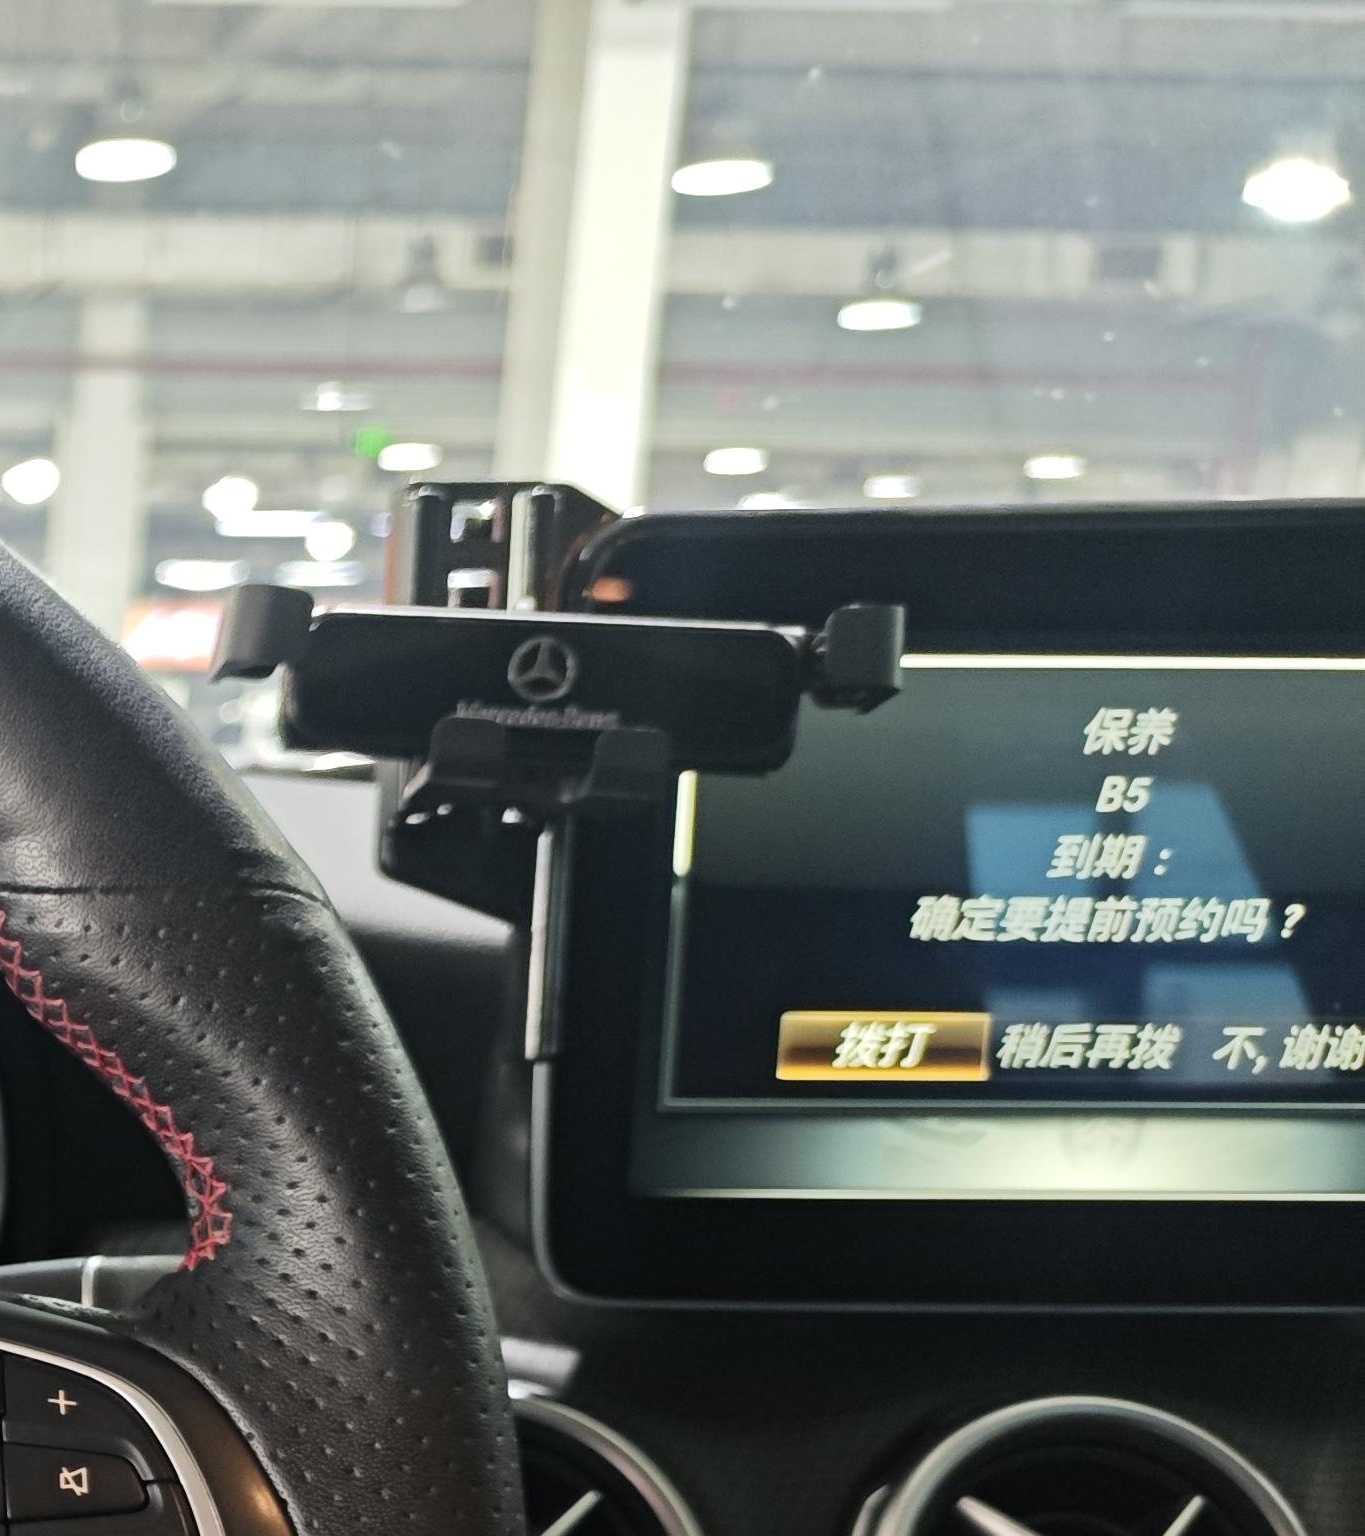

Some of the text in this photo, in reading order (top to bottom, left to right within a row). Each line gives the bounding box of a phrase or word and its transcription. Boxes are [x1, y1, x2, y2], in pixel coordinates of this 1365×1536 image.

[1082, 707, 1178, 755] 保养
[1095, 776, 1153, 813] B5
[832, 1022, 935, 1069] 拨打
[996, 1021, 1183, 1070] 稍后再拨
